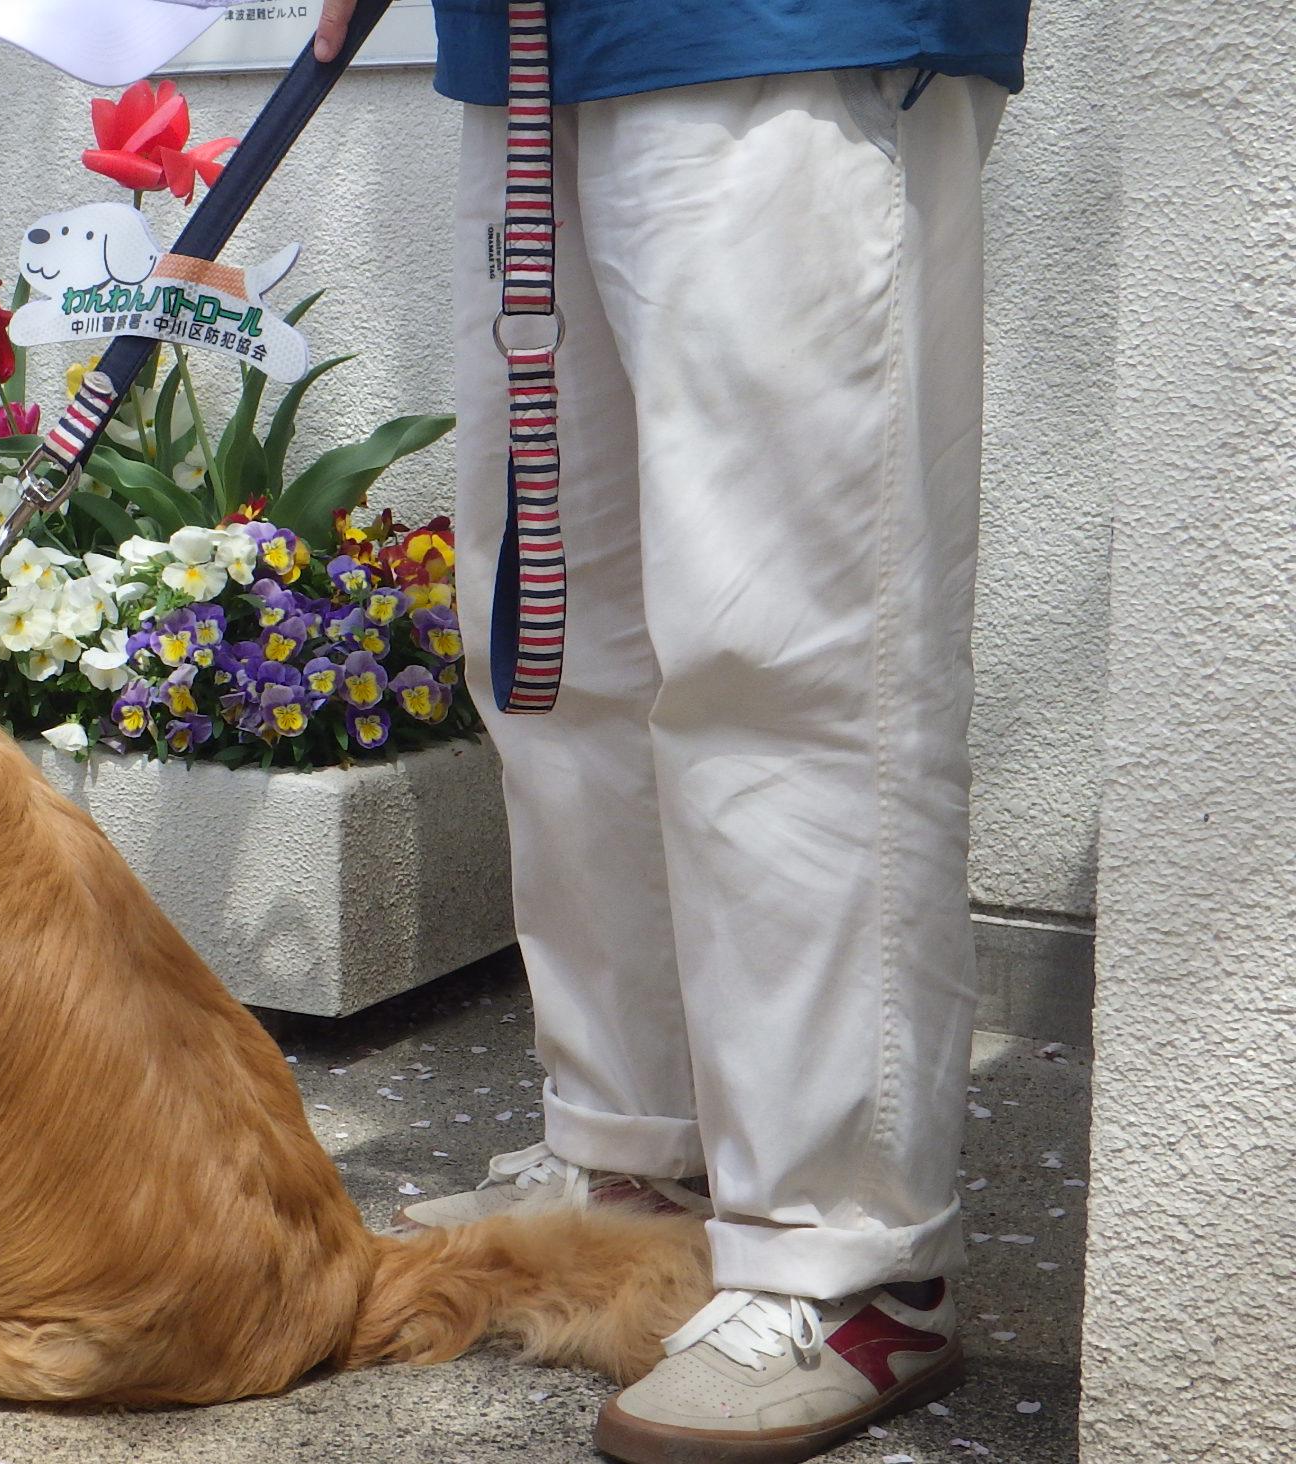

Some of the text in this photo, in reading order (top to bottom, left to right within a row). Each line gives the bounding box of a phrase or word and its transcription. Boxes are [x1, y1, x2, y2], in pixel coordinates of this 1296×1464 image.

[225, 6, 307, 21] 津波避難ビル入口
[62, 285, 263, 338] わんわんパトロール
[70, 313, 268, 362] 中川警察署・中川区防犯協会
